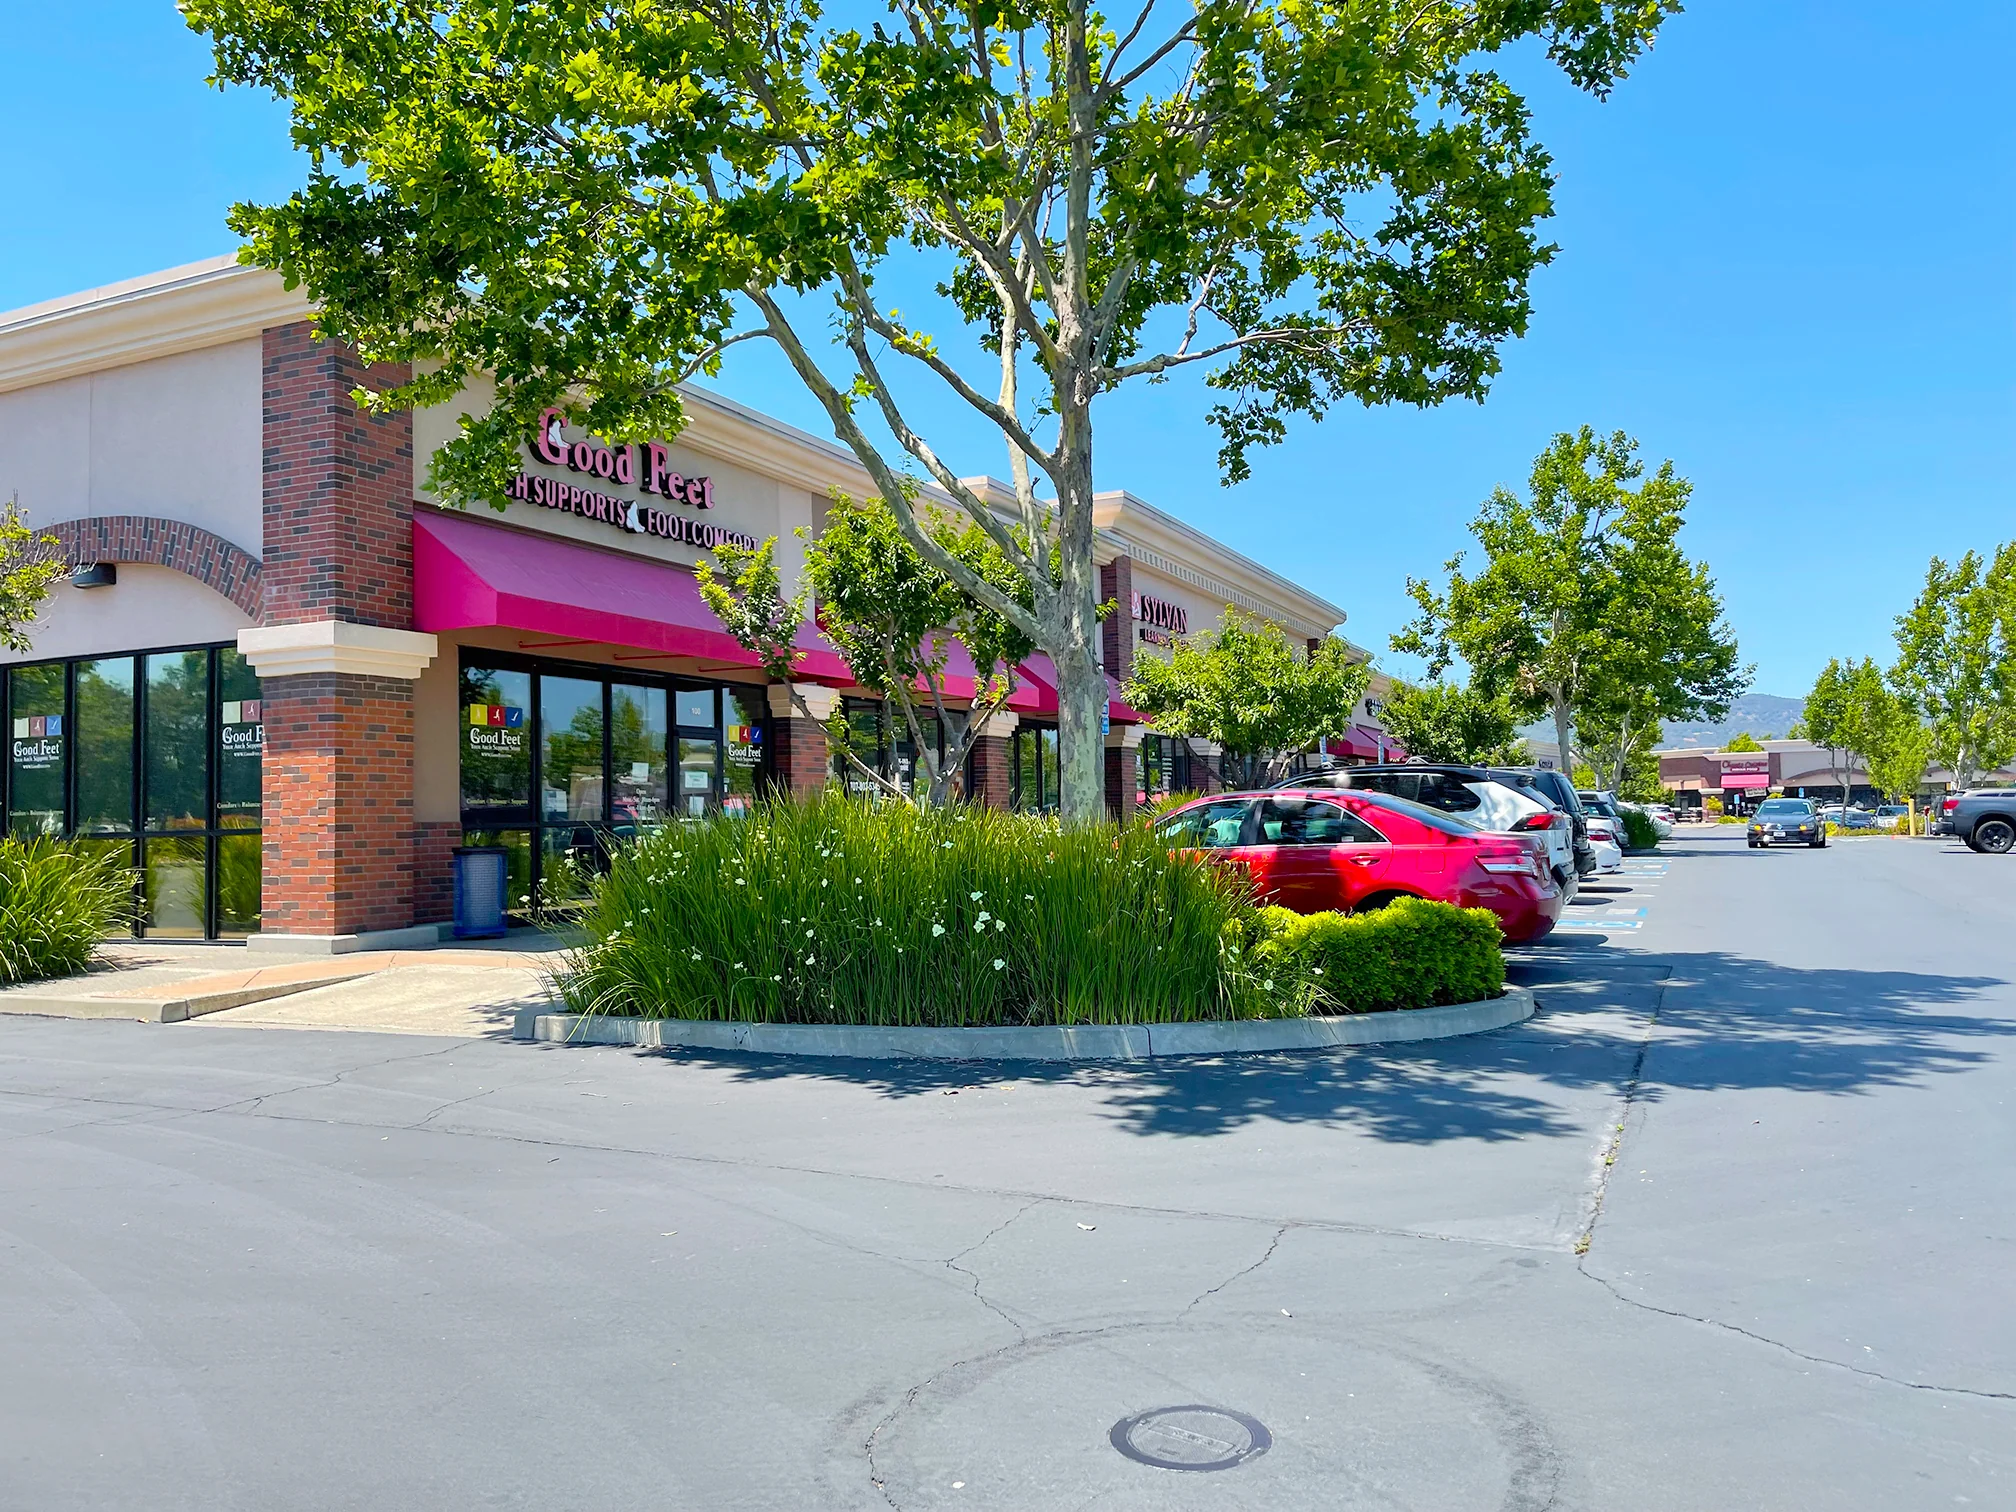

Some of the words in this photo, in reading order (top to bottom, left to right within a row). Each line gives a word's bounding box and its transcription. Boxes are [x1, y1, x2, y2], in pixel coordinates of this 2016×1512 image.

[537, 407, 636, 484] Good
[649, 442, 715, 510] Feet
[533, 475, 626, 526] SUPPORTS
[647, 507, 688, 541] FOOT
[1144, 595, 1188, 634] SYLVAN
[221, 726, 252, 744] Good
[470, 727, 499, 744] Good
[500, 729, 522, 745] Feet
[13, 740, 39, 757] Good
[40, 739, 60, 756] Feet
[728, 743, 747, 757] Good
[747, 744, 761, 758] Feet
